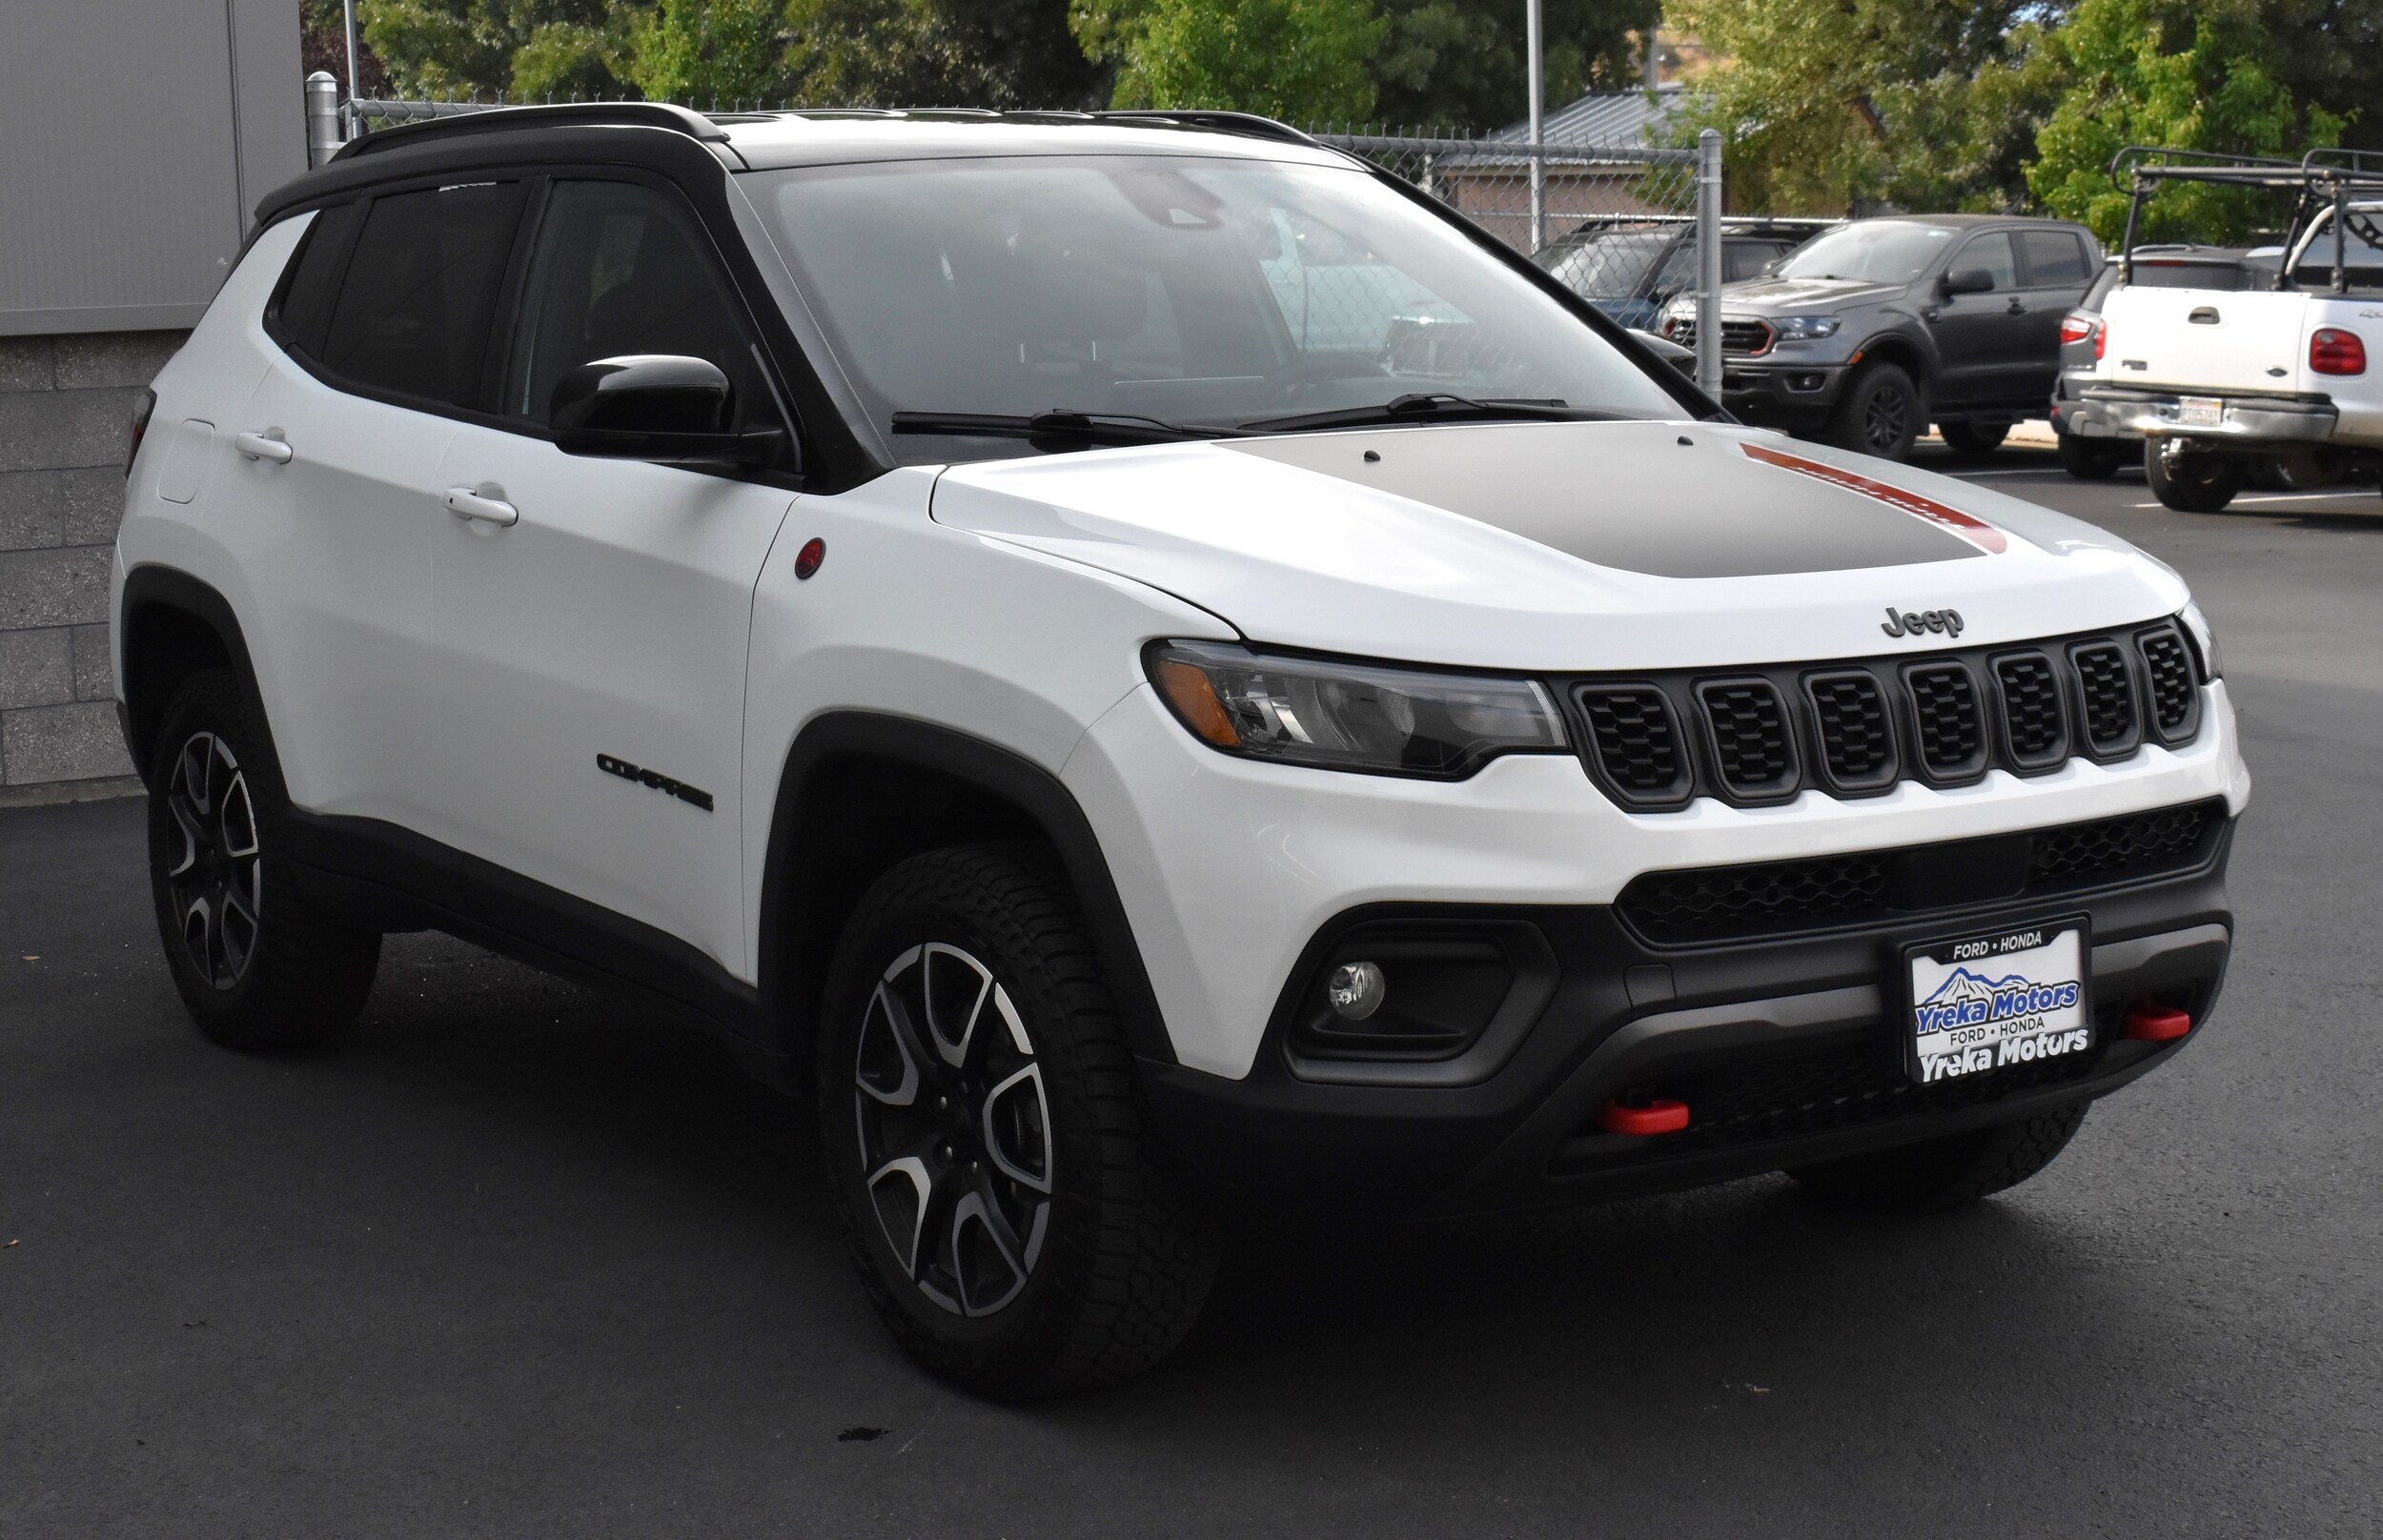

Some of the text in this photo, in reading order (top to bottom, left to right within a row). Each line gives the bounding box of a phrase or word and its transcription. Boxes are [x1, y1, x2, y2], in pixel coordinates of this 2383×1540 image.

[1881, 607, 1965, 638] Jeep
[1953, 930, 2042, 960] FORD HONDA
[1915, 982, 2079, 1035] Yreka Motors
[1950, 1016, 2045, 1045] FORD HONDA
[1920, 1028, 2088, 1083] Yreka Motors
